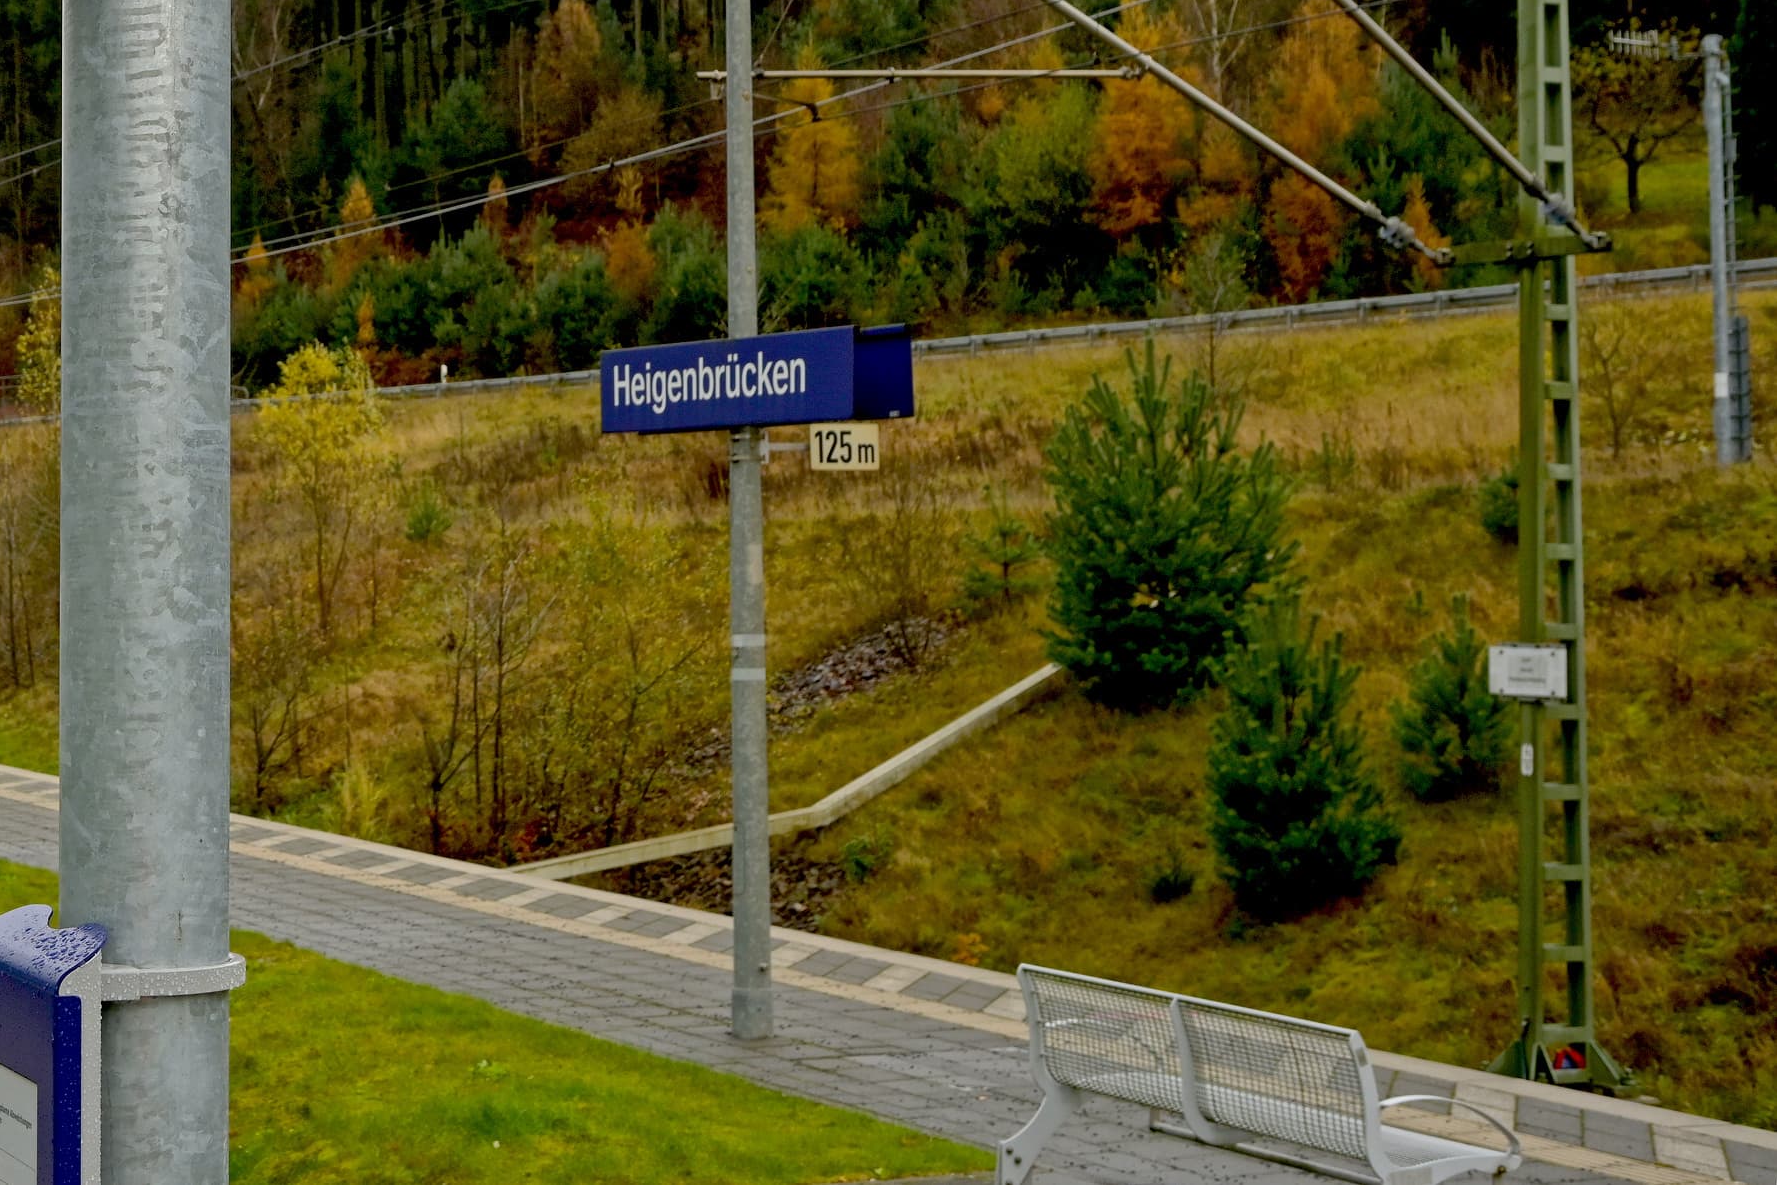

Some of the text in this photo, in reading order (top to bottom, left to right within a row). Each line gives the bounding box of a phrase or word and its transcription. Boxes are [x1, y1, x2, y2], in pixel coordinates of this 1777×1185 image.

[613, 351, 807, 414] Heigenbrücken
[814, 430, 875, 464] 125 m
